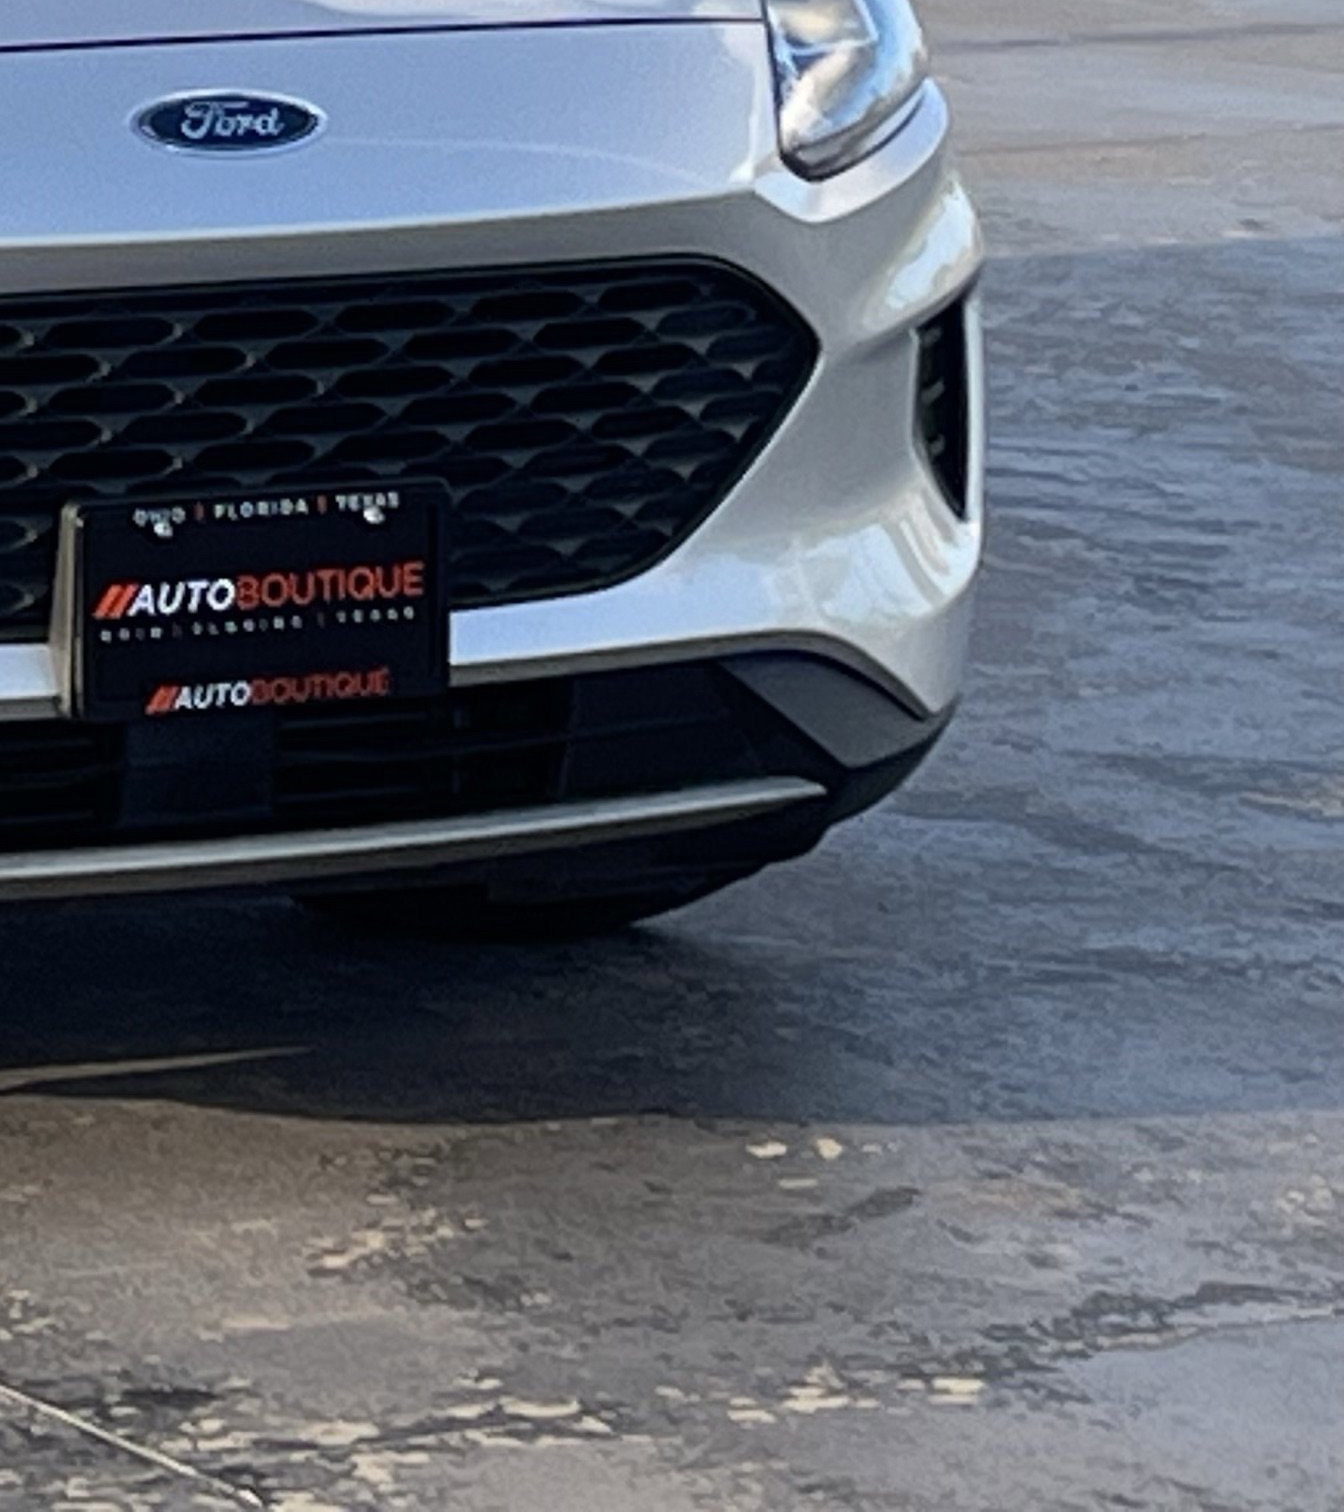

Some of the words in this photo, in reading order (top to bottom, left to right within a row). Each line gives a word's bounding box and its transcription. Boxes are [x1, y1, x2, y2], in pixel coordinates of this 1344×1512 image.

[181, 101, 284, 139] Ford
[214, 498, 310, 521] FLORIDA
[335, 491, 400, 512] TEXAS
